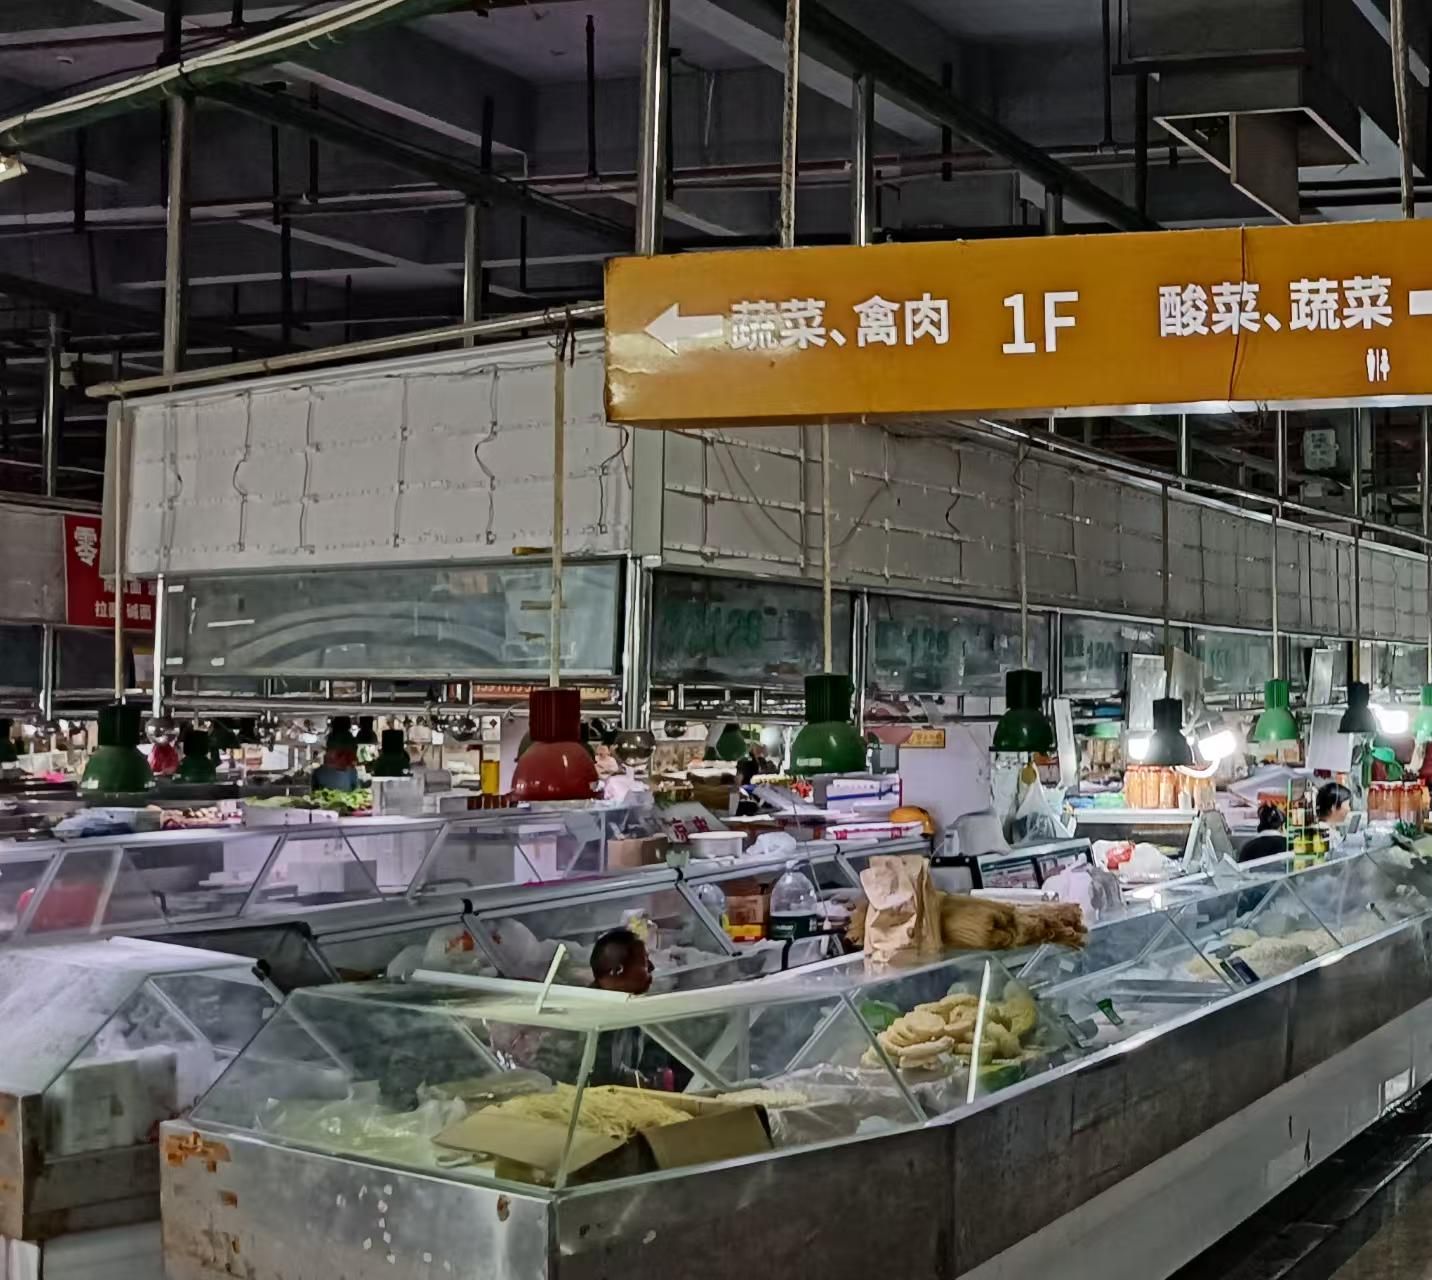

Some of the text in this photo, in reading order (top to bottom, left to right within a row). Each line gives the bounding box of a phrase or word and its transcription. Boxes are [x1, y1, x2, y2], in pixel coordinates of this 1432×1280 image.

[727, 274, 1393, 355] 蔬菜、禽肉 1F 酸菜、蔬菜
